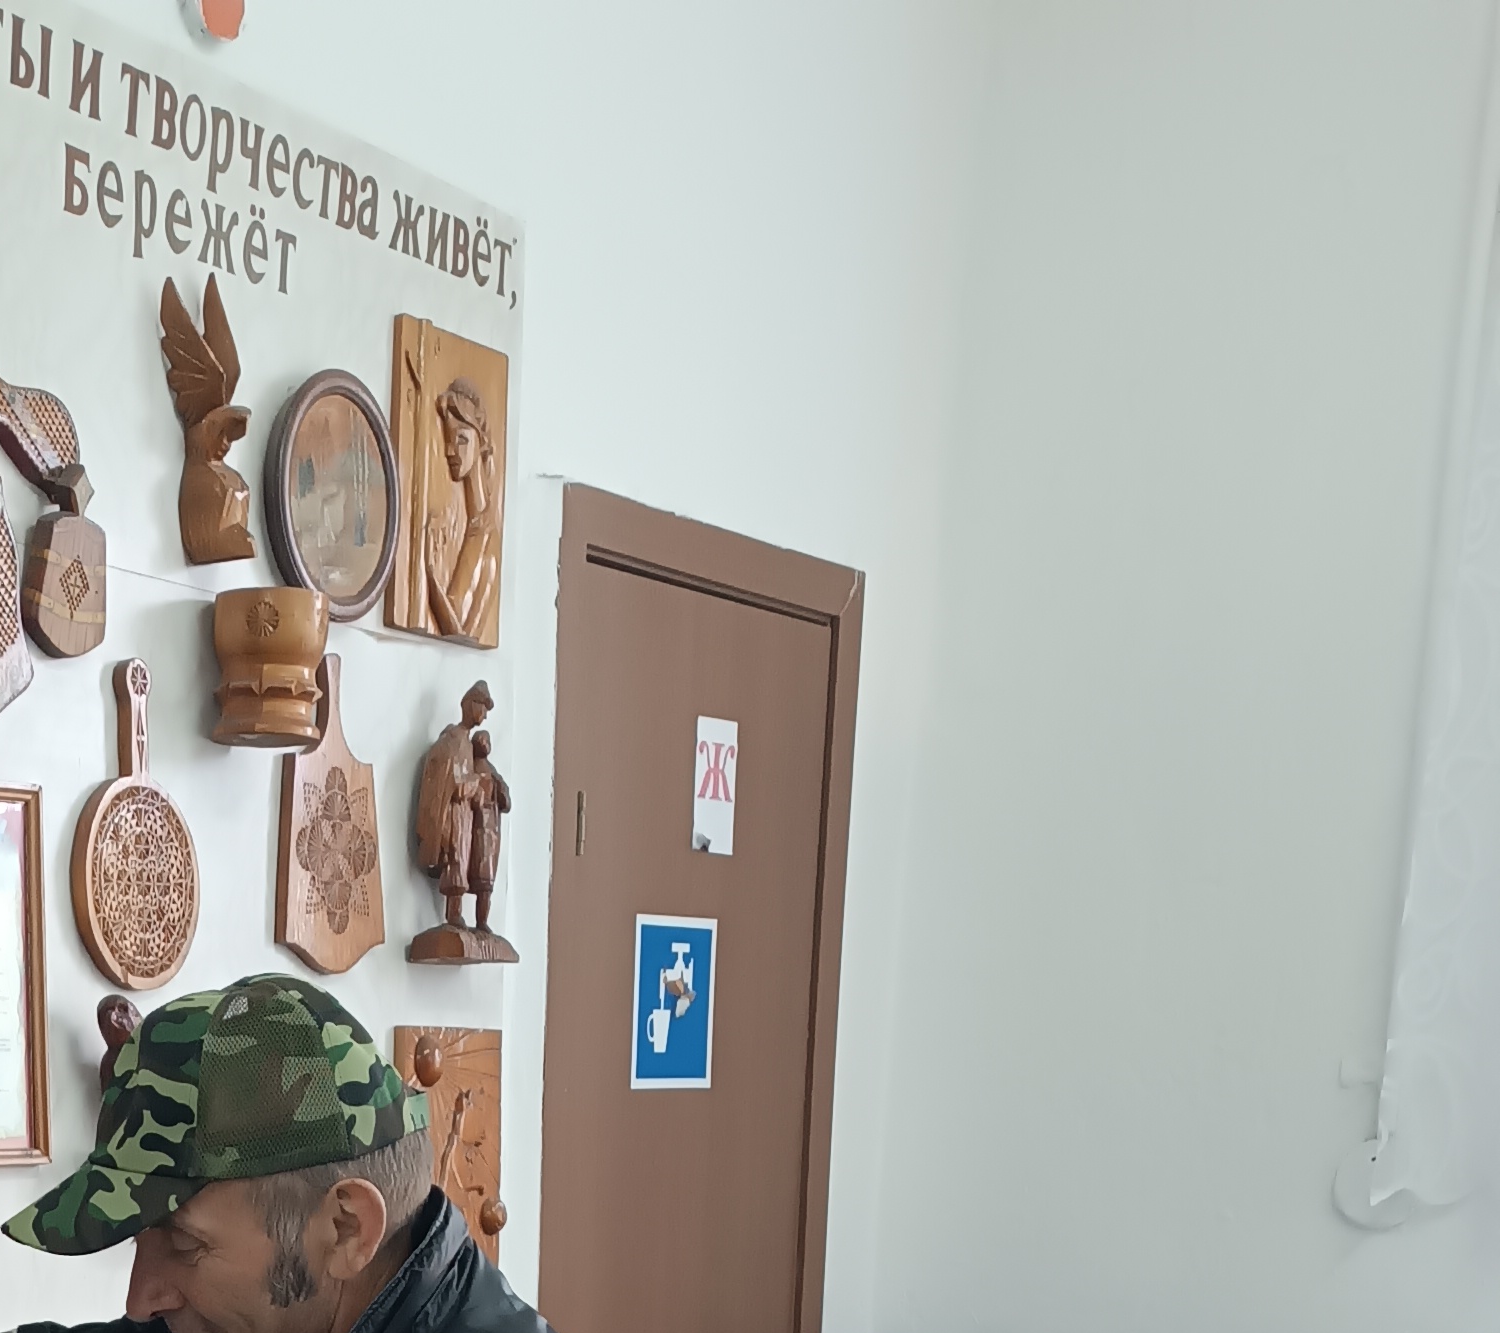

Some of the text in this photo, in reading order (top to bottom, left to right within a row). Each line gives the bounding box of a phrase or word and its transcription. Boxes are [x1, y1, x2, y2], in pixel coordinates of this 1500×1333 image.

[69, 39, 104, 120] и
[120, 63, 380, 240] творчества
[389, 189, 518, 309] живёт,
[697, 741, 735, 802] Ж
